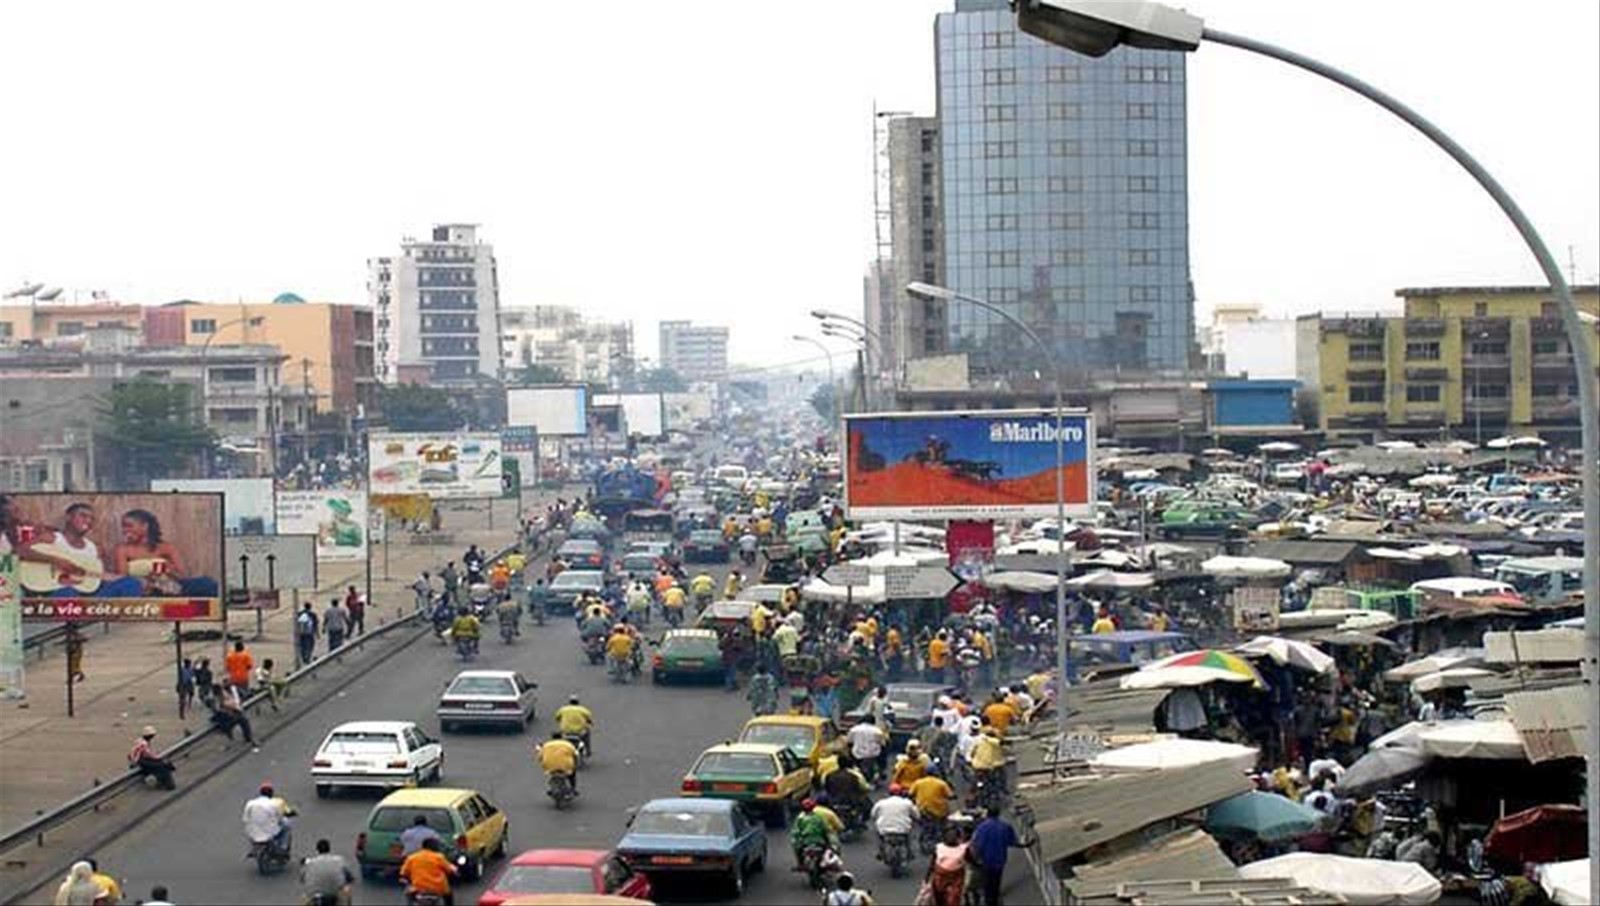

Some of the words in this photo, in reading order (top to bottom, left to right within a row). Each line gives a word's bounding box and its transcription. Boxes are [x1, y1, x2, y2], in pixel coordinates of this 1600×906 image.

[1003, 422, 1083, 442] Marlboro
[24, 605, 35, 615] e
[38, 603, 54, 615] la
[57, 602, 82, 615] vie
